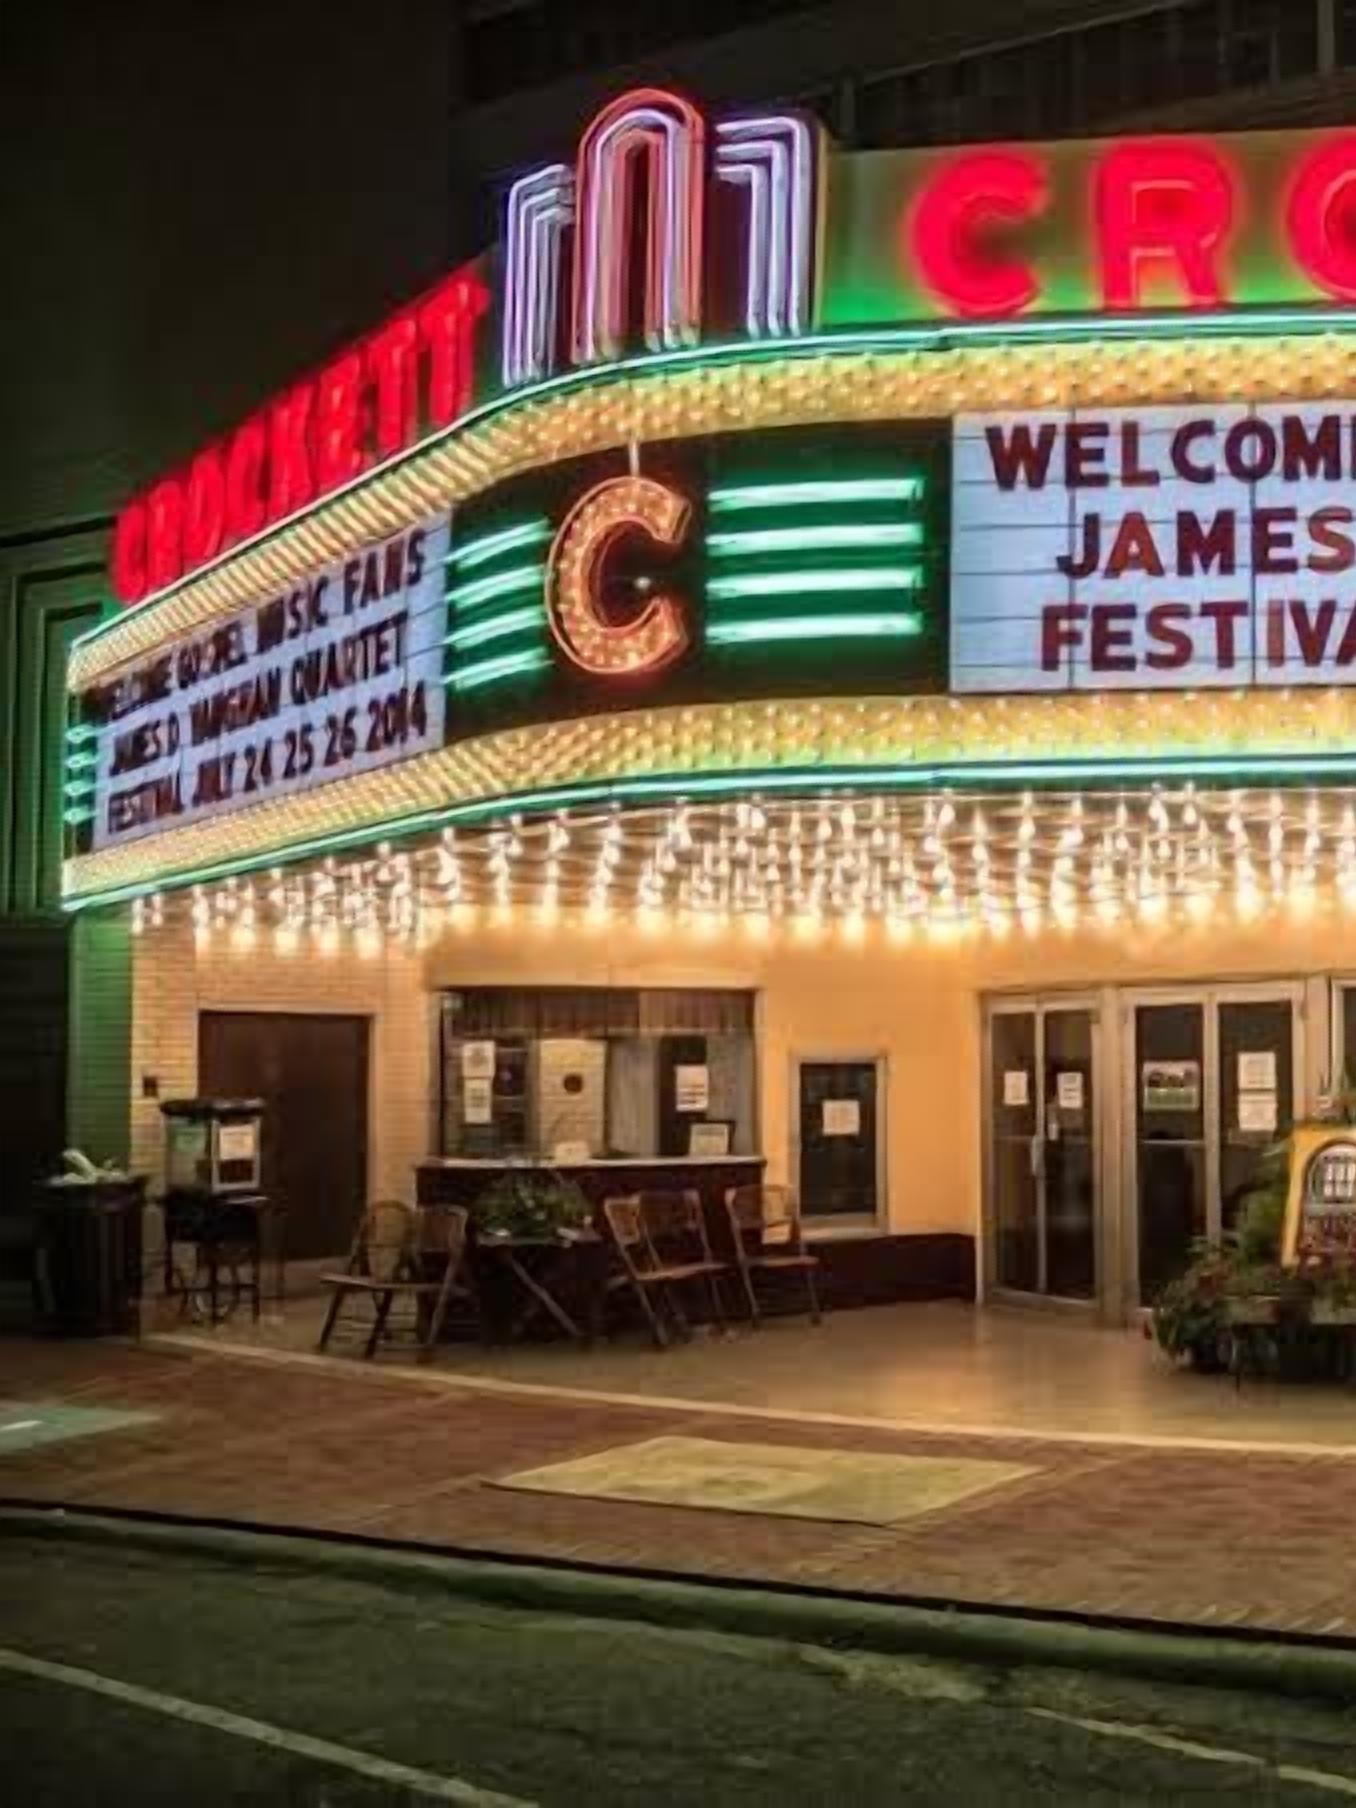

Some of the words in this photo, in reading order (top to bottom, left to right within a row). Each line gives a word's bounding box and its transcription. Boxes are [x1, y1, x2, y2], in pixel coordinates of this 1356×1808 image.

[110, 267, 490, 605] CROCKETT
[343, 526, 426, 616] FANS
[546, 475, 692, 674] C
[1056, 506, 1356, 578] JAMES
[291, 609, 409, 706] QUARTET
[244, 737, 273, 794] 24
[282, 723, 315, 780] 25
[323, 705, 358, 768] 26
